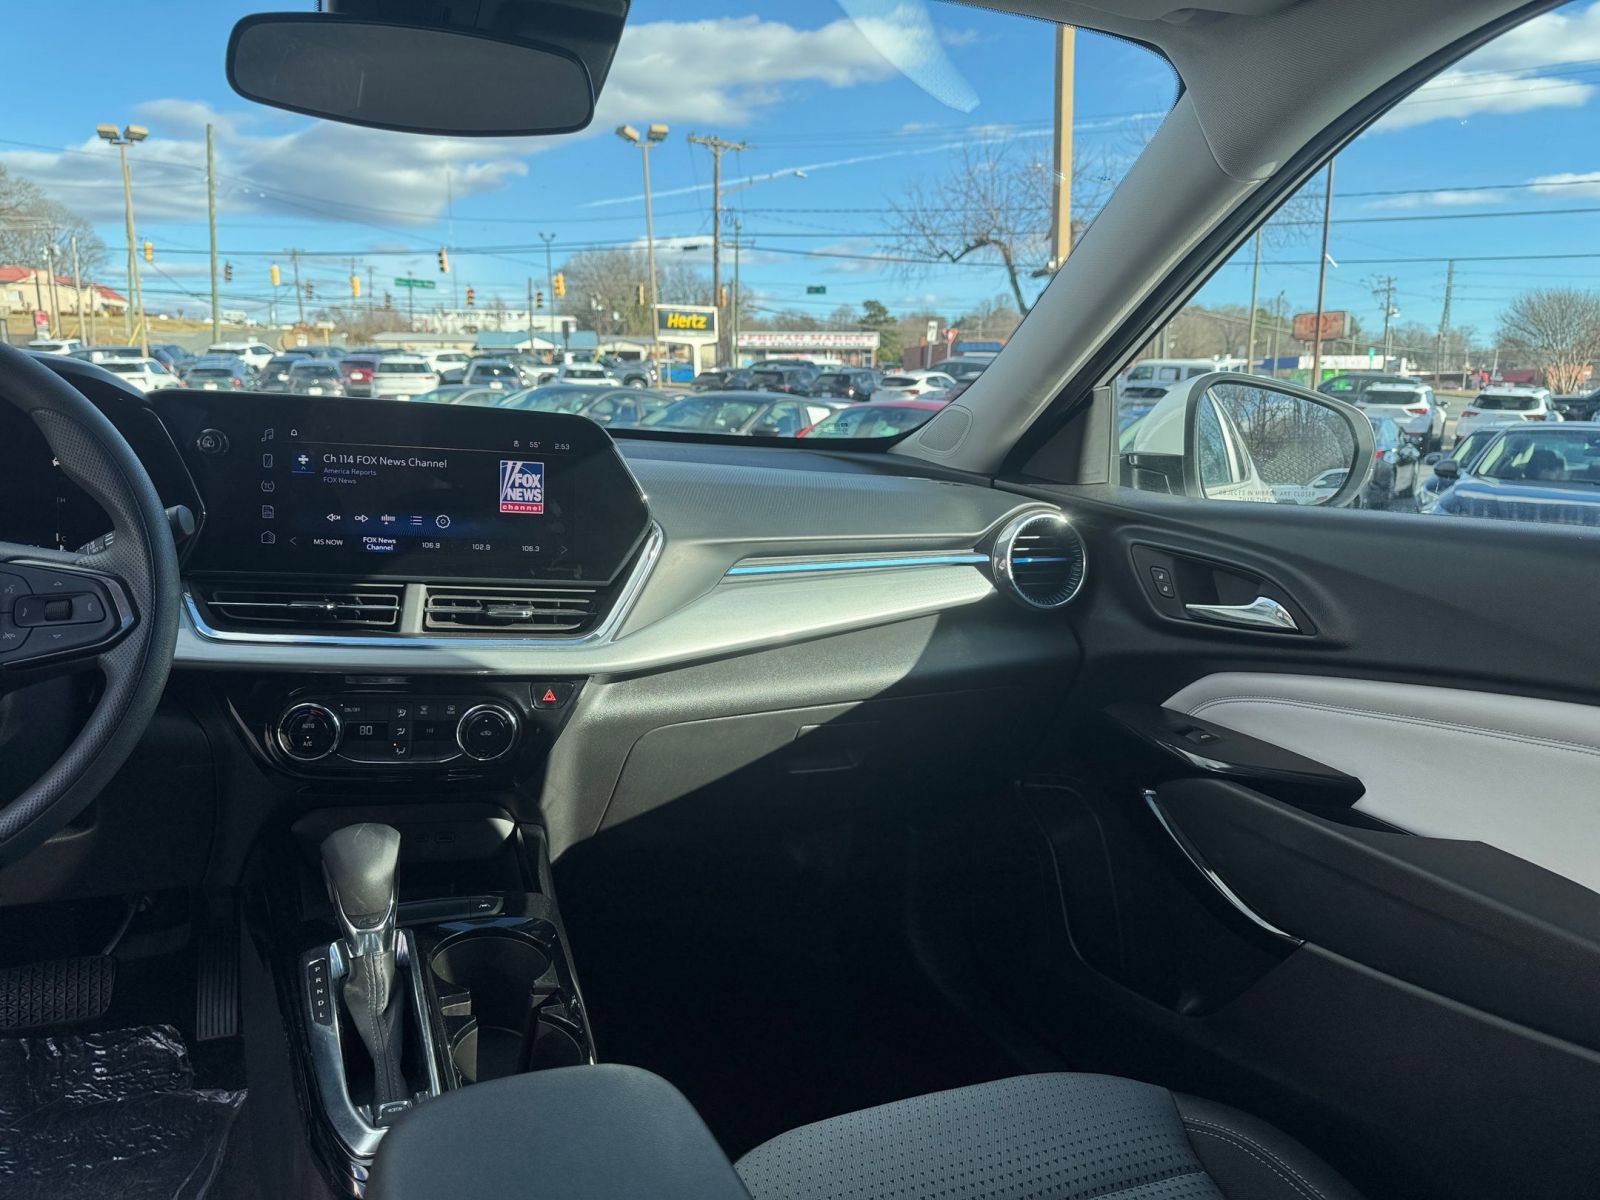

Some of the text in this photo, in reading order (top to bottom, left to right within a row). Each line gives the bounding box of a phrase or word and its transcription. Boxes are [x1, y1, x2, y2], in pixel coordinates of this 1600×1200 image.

[667, 312, 707, 329] Hertz
[323, 454, 447, 468] Ch 114 FOX News Channel
[323, 467, 377, 476] America Reports
[338, 477, 357, 485] News
[514, 473, 541, 488] FOX
[506, 487, 542, 502] NEWS
[366, 543, 394, 551] Channel
